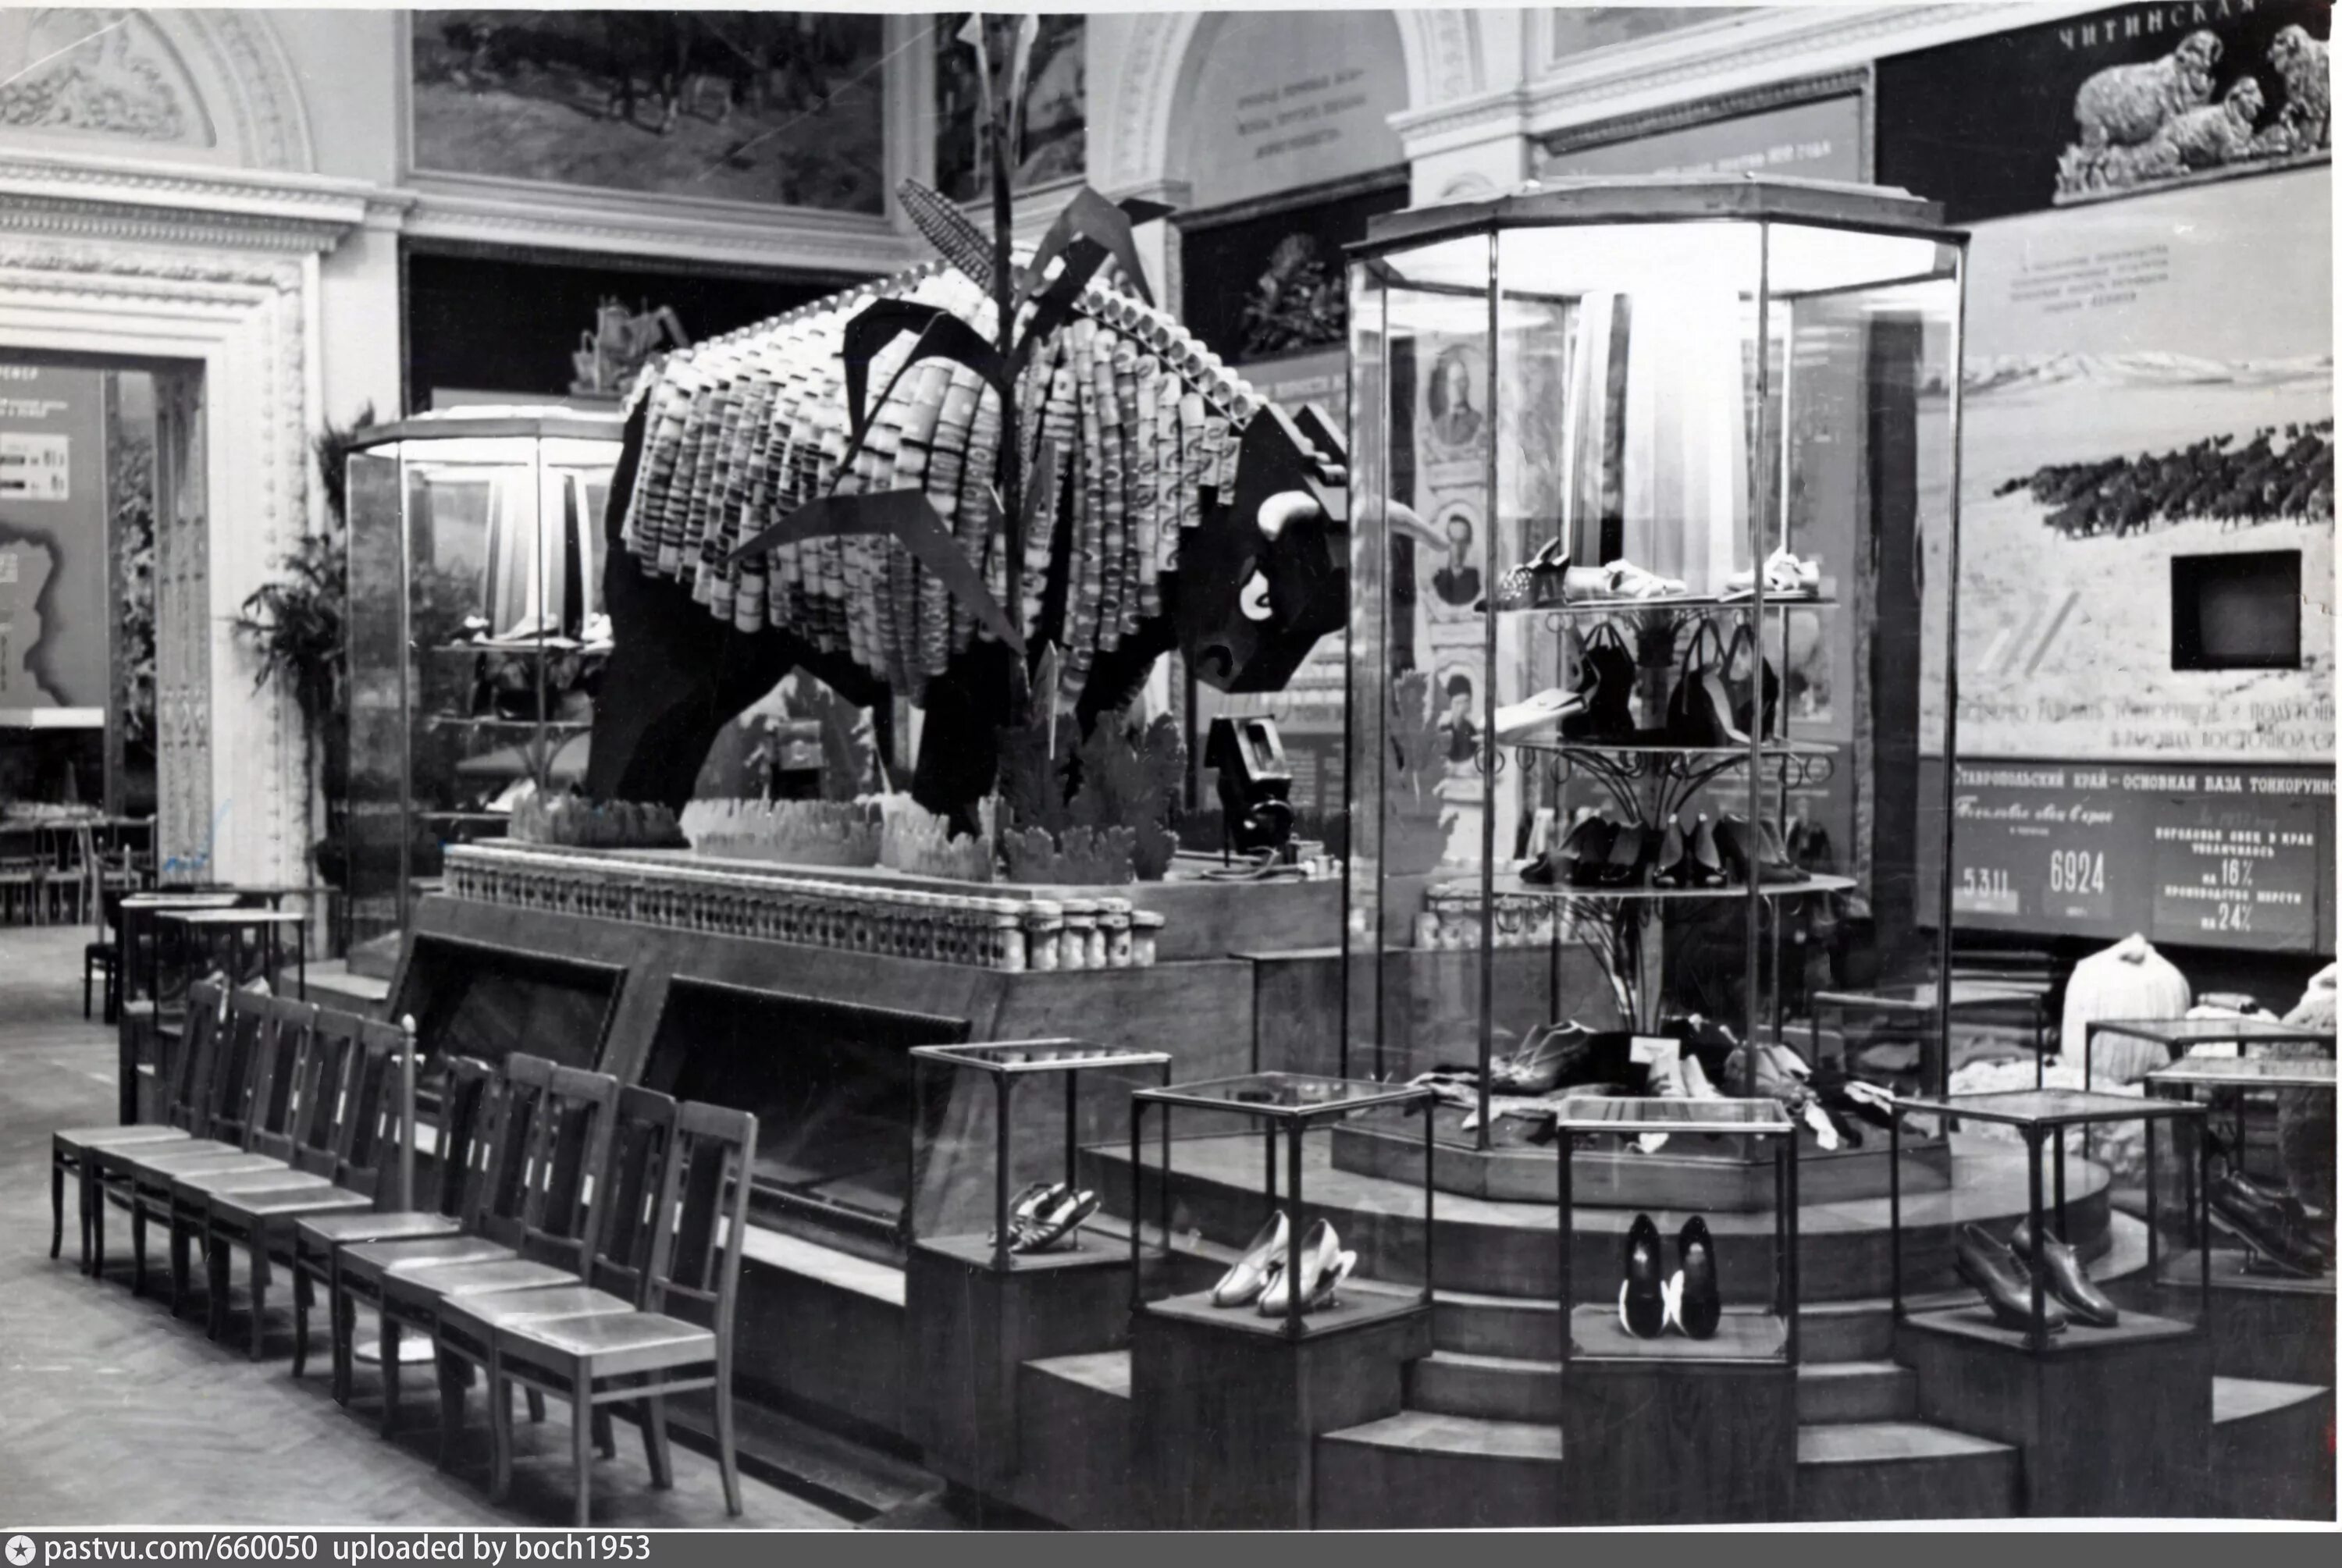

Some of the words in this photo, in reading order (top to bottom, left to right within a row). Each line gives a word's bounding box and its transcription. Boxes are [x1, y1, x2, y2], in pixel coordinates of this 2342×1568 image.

[2122, 773, 2196, 791] ОСНОВНАЯ
[2205, 775, 2243, 792] БАЗА
[1963, 868, 2008, 898] 5311
[2050, 849, 2105, 894] 6924
[2222, 859, 2253, 886] 16%
[2219, 902, 2252, 931] 24%
